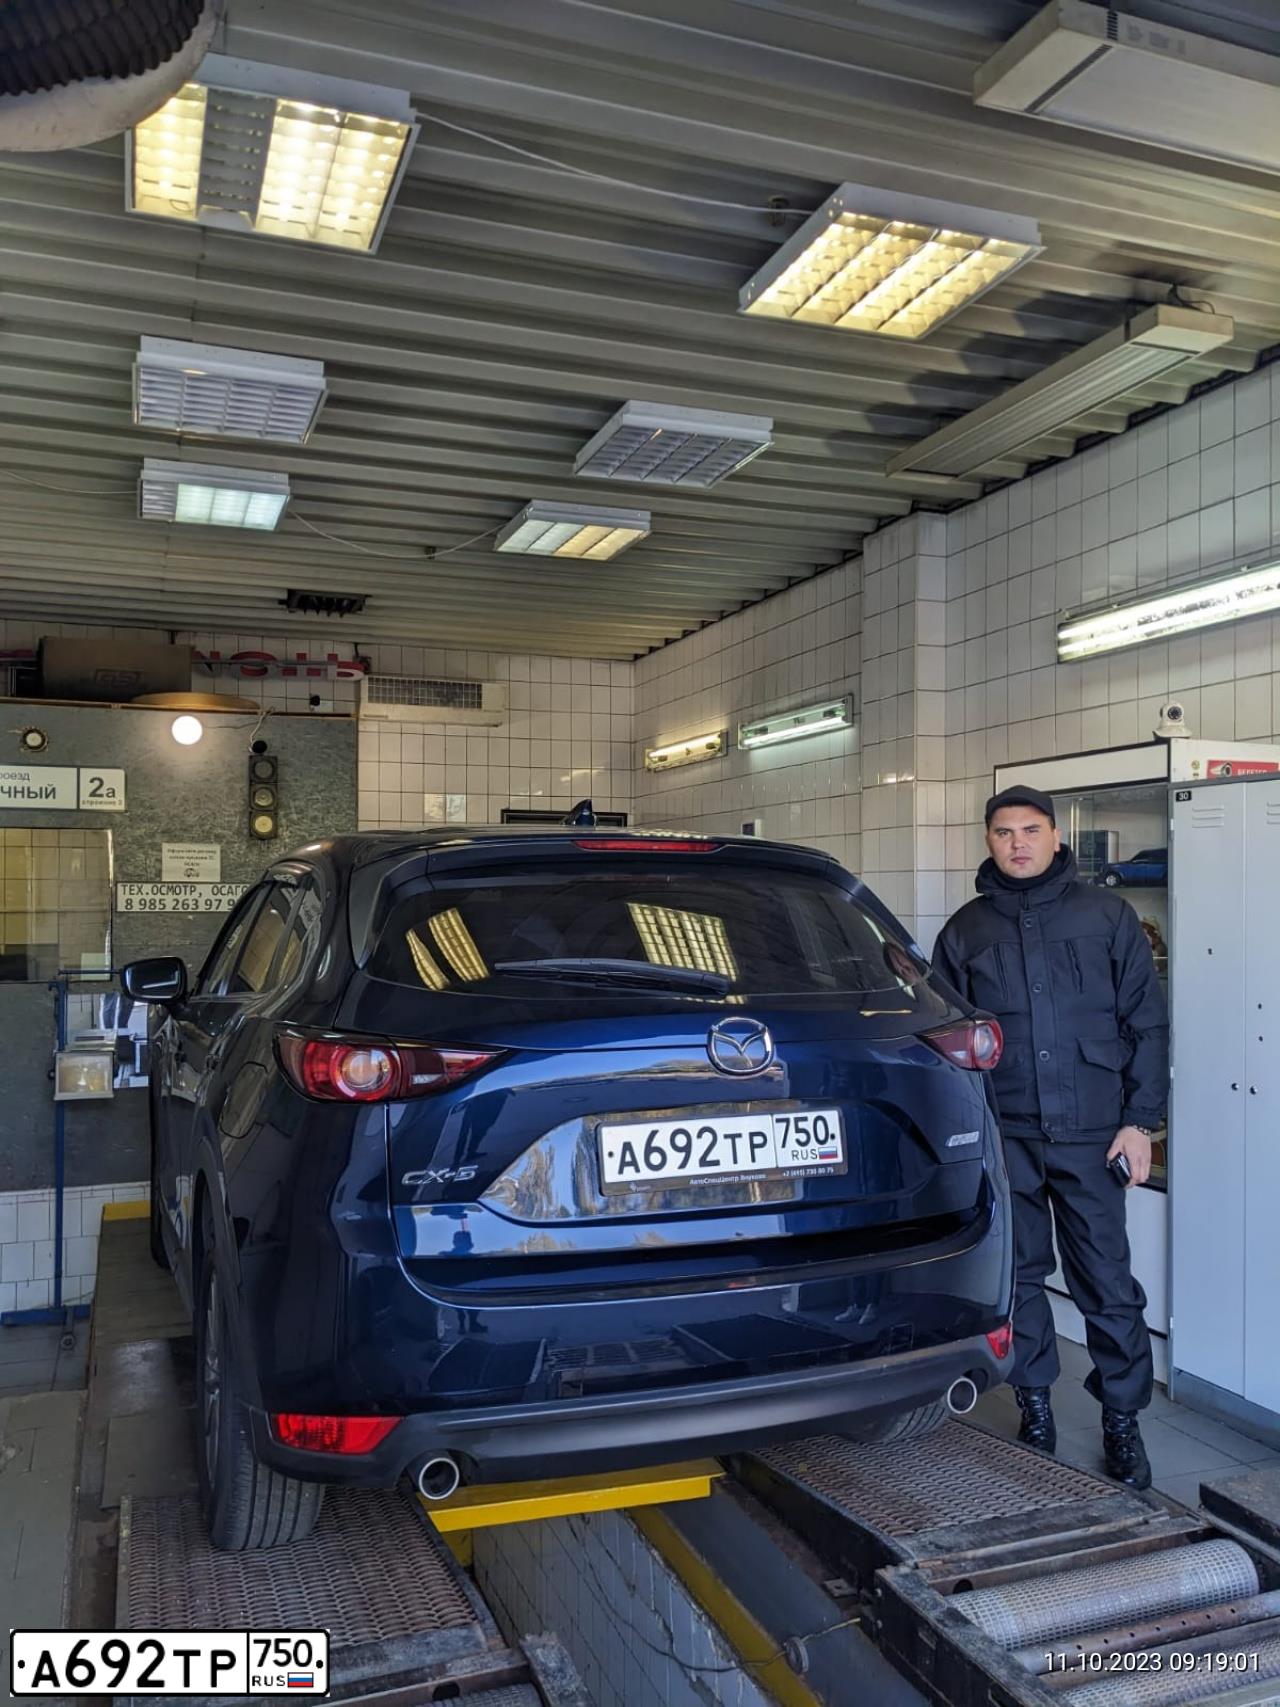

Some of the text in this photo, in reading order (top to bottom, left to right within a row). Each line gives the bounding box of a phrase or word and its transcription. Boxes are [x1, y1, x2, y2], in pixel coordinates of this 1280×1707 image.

[121, 884, 202, 898] ТЕХ.ОСМОТР,
[124, 898, 134, 911] 8
[138, 898, 167, 911] 985
[171, 898, 200, 911] 263
[204, 898, 222, 911] 97
[617, 1114, 831, 1176] А692ТР 750
[791, 1148, 818, 1161] RUS
[401, 1164, 479, 1185] CX-5
